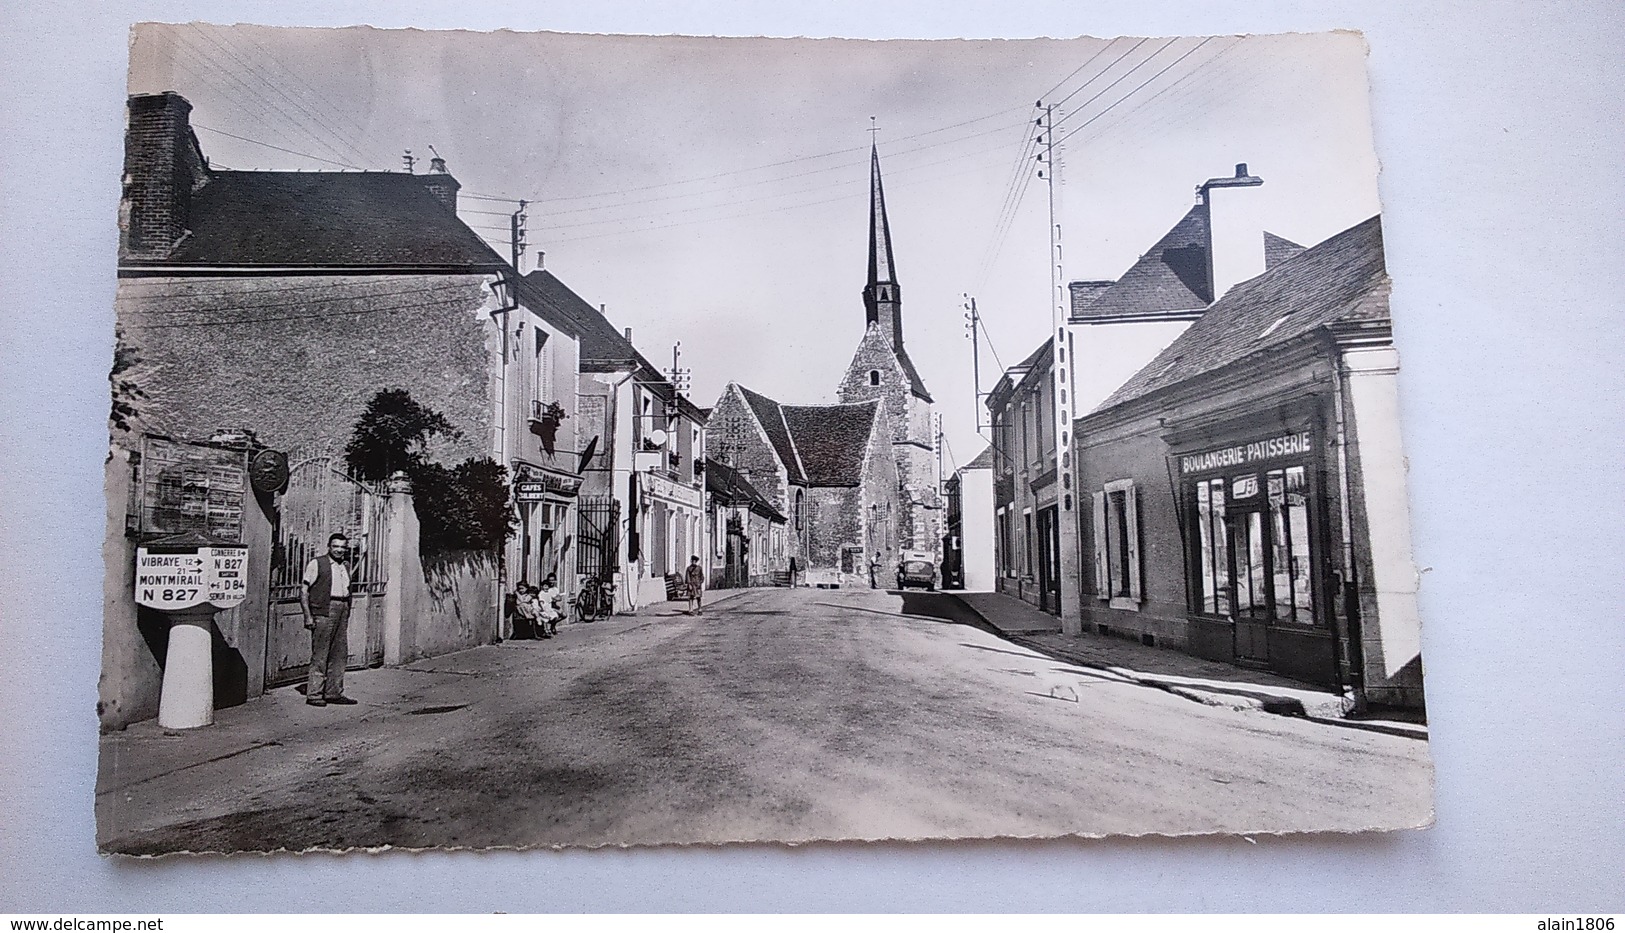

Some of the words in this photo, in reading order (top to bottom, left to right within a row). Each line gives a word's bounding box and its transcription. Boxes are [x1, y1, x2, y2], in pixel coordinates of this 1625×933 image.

[141, 557, 180, 567] VIBRAYE
[214, 559, 220, 569] N
[224, 559, 243, 569] 827
[140, 576, 203, 585] MONTMIRAIL
[225, 580, 231, 590] D
[232, 580, 245, 590] 84
[143, 589, 154, 601] N
[162, 589, 199, 601] 827
